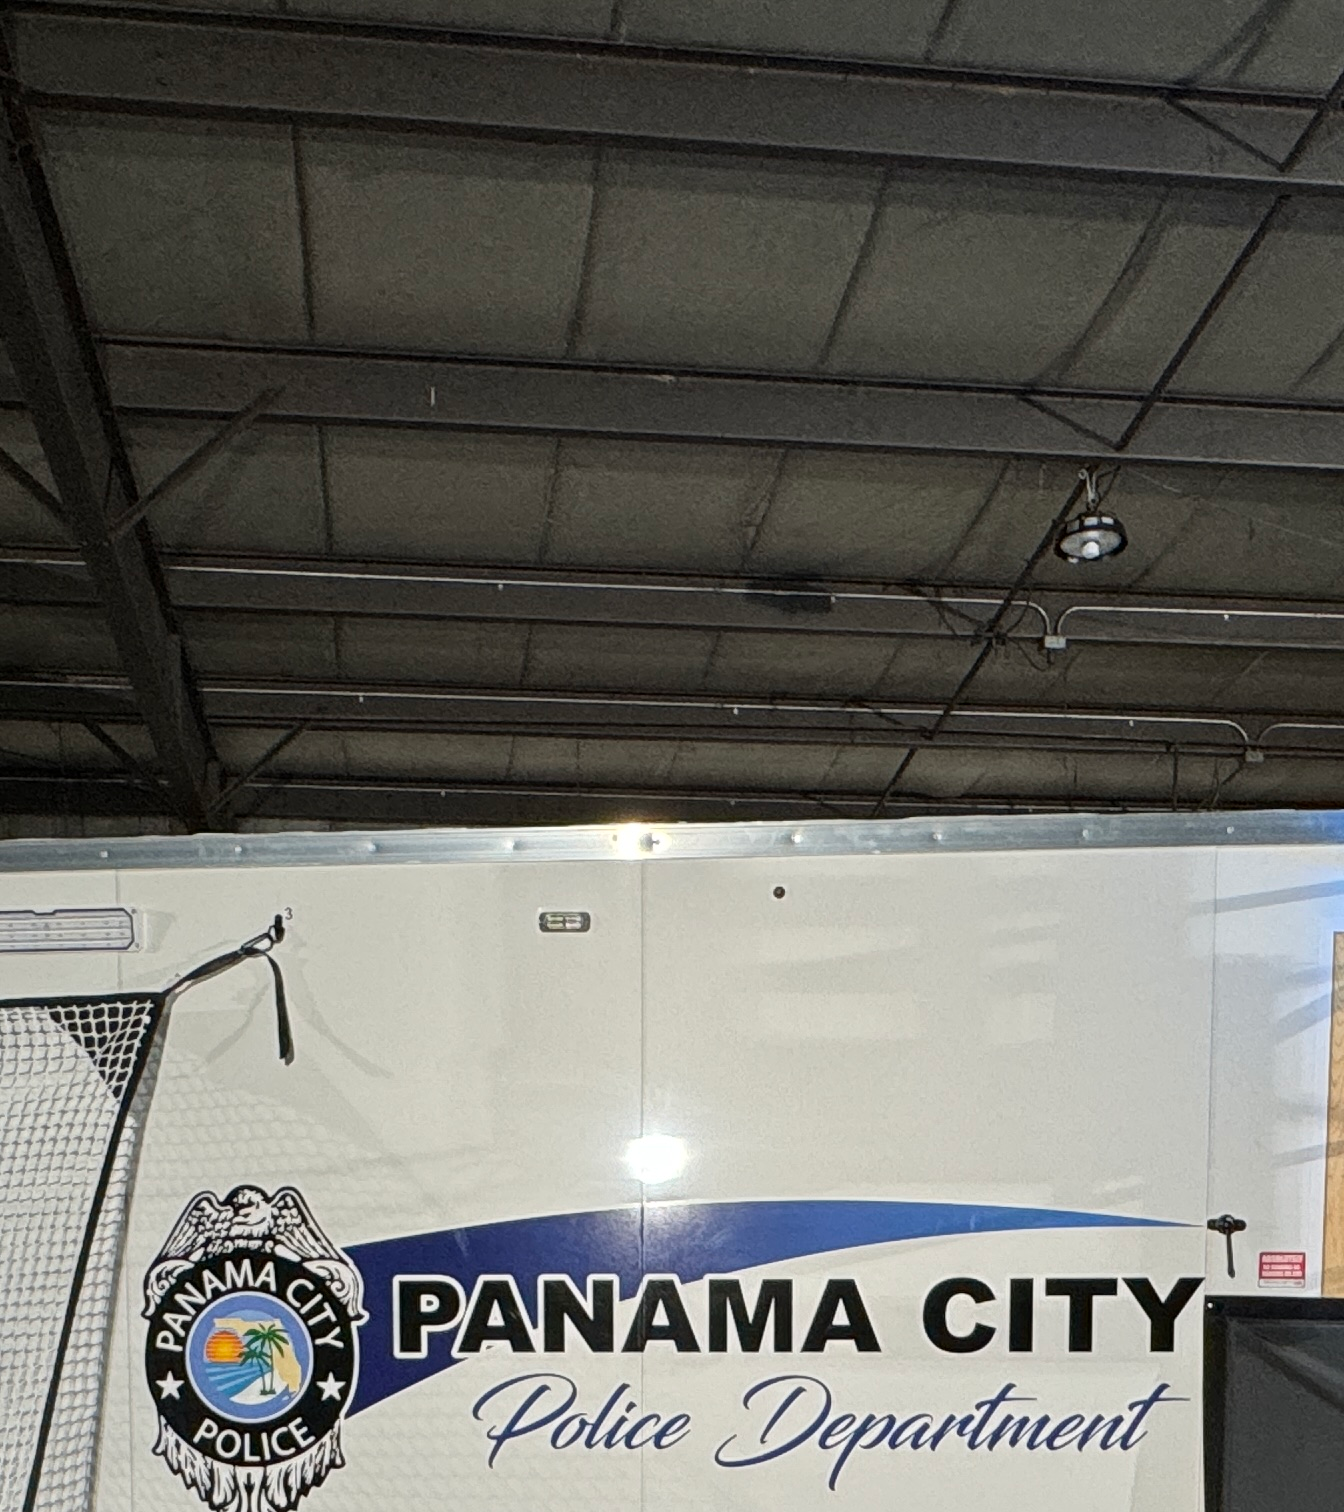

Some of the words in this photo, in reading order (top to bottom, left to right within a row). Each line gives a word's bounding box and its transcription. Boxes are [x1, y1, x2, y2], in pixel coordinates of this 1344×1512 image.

[284, 907, 293, 920] 3
[155, 1258, 277, 1353] PANAMA
[285, 1278, 344, 1350] CITY
[398, 1278, 882, 1354] PANAMA
[922, 1277, 1205, 1354] CITY
[193, 1416, 316, 1463] POLICE
[471, 1372, 691, 1469] Police
[713, 1374, 1192, 1492] Department
